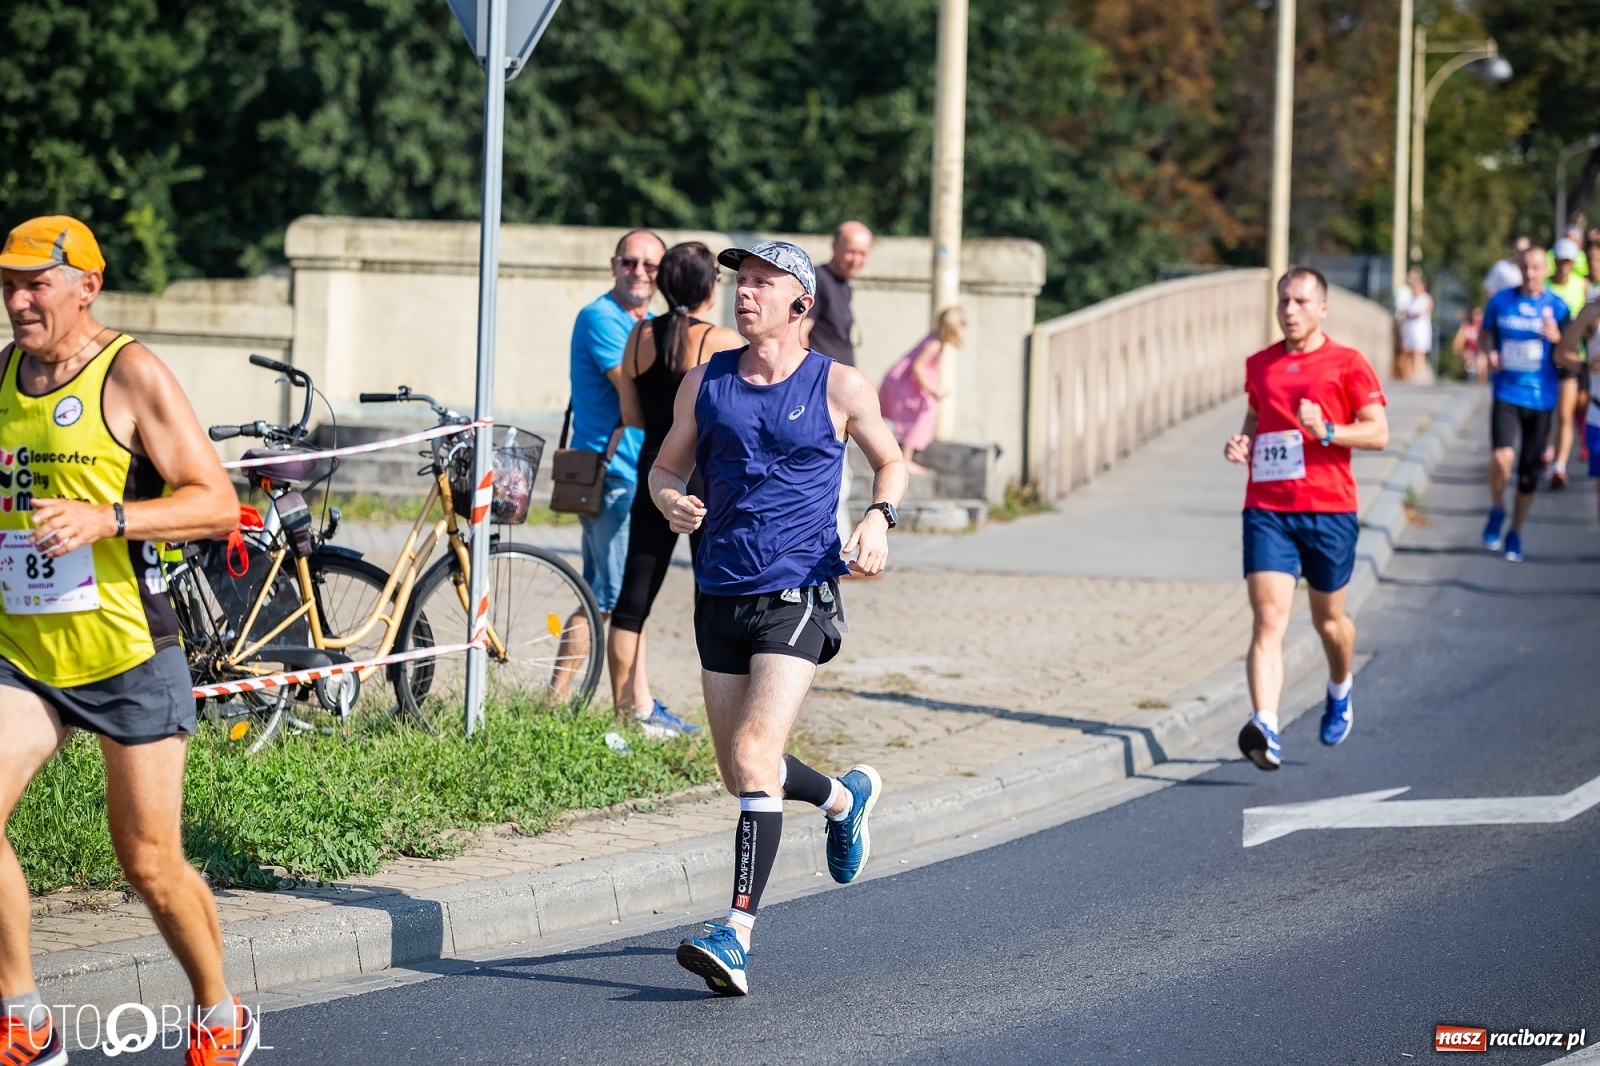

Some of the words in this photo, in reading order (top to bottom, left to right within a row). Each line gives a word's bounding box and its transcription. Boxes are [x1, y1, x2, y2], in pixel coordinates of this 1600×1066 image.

[17, 446, 97, 466] Gloucester
[17, 469, 49, 490] City
[26, 553, 55, 580] 83
